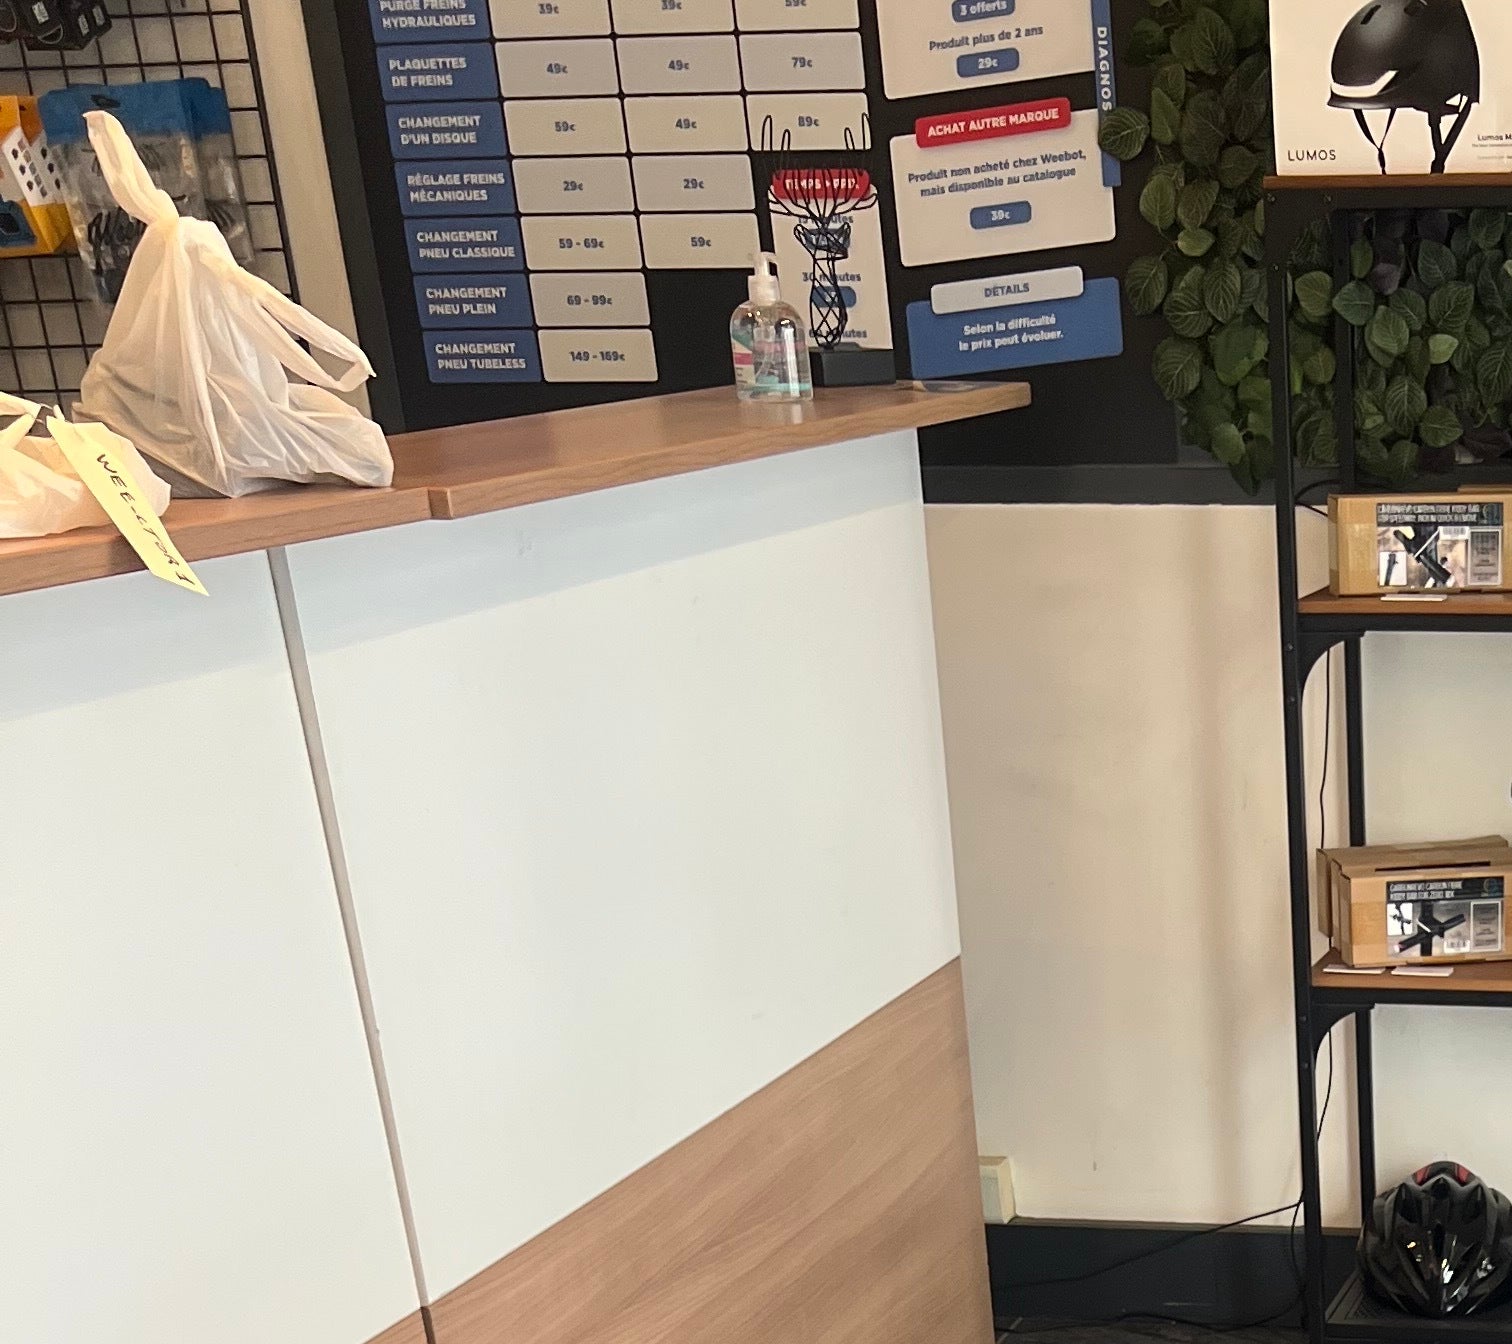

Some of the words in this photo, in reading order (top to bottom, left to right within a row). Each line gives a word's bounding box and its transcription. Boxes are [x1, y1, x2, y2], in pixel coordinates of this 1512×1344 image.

[382, 14, 476, 28] HYDRAULIQUES
[929, 36, 970, 51] Produit
[972, 33, 995, 47] plus
[998, 29, 1012, 41] de
[1015, 28, 1022, 38] 2
[1024, 27, 1044, 37] ans
[389, 57, 467, 71] PLAQUETTES
[1097, 27, 1113, 111] DIAGNOS
[392, 75, 407, 87] DE
[411, 74, 453, 87] FREINS
[398, 115, 481, 129] CHANGEMENT
[928, 122, 965, 138] ACHAT
[969, 116, 1006, 131] AUTRE
[1009, 108, 1059, 125] MARQUE
[401, 133, 429, 145] D'UN
[432, 131, 477, 145] DISQUE
[1288, 150, 1336, 161] LUMOS
[908, 169, 947, 183] Produit
[950, 168, 971, 178] non
[974, 160, 1010, 174] acheté
[1013, 156, 1038, 169] chez
[407, 172, 461, 186] RÉGLAGE
[463, 172, 505, 185] FREINS
[920, 185, 946, 197] mais
[948, 175, 1004, 193] disponible
[1007, 175, 1020, 185] au
[1023, 168, 1076, 183] catalogue
[410, 188, 488, 202] MÉCANIQUES
[417, 230, 498, 242] CHANGEMENT
[419, 247, 449, 258] PNEU
[452, 246, 515, 258] CLASSIQUE
[426, 287, 507, 299] CHANGEMENT
[429, 304, 460, 315] PNEU
[463, 303, 497, 314] PLEIN
[963, 322, 993, 336] Selon
[996, 320, 1006, 332] la
[1008, 313, 1056, 329] difficulté
[435, 343, 515, 355] CHANGEMENT
[959, 340, 970, 351] le
[971, 337, 992, 352] prix
[994, 335, 1020, 351] peut
[438, 359, 468, 369] PNEU
[470, 358, 526, 369] TUBELESS
